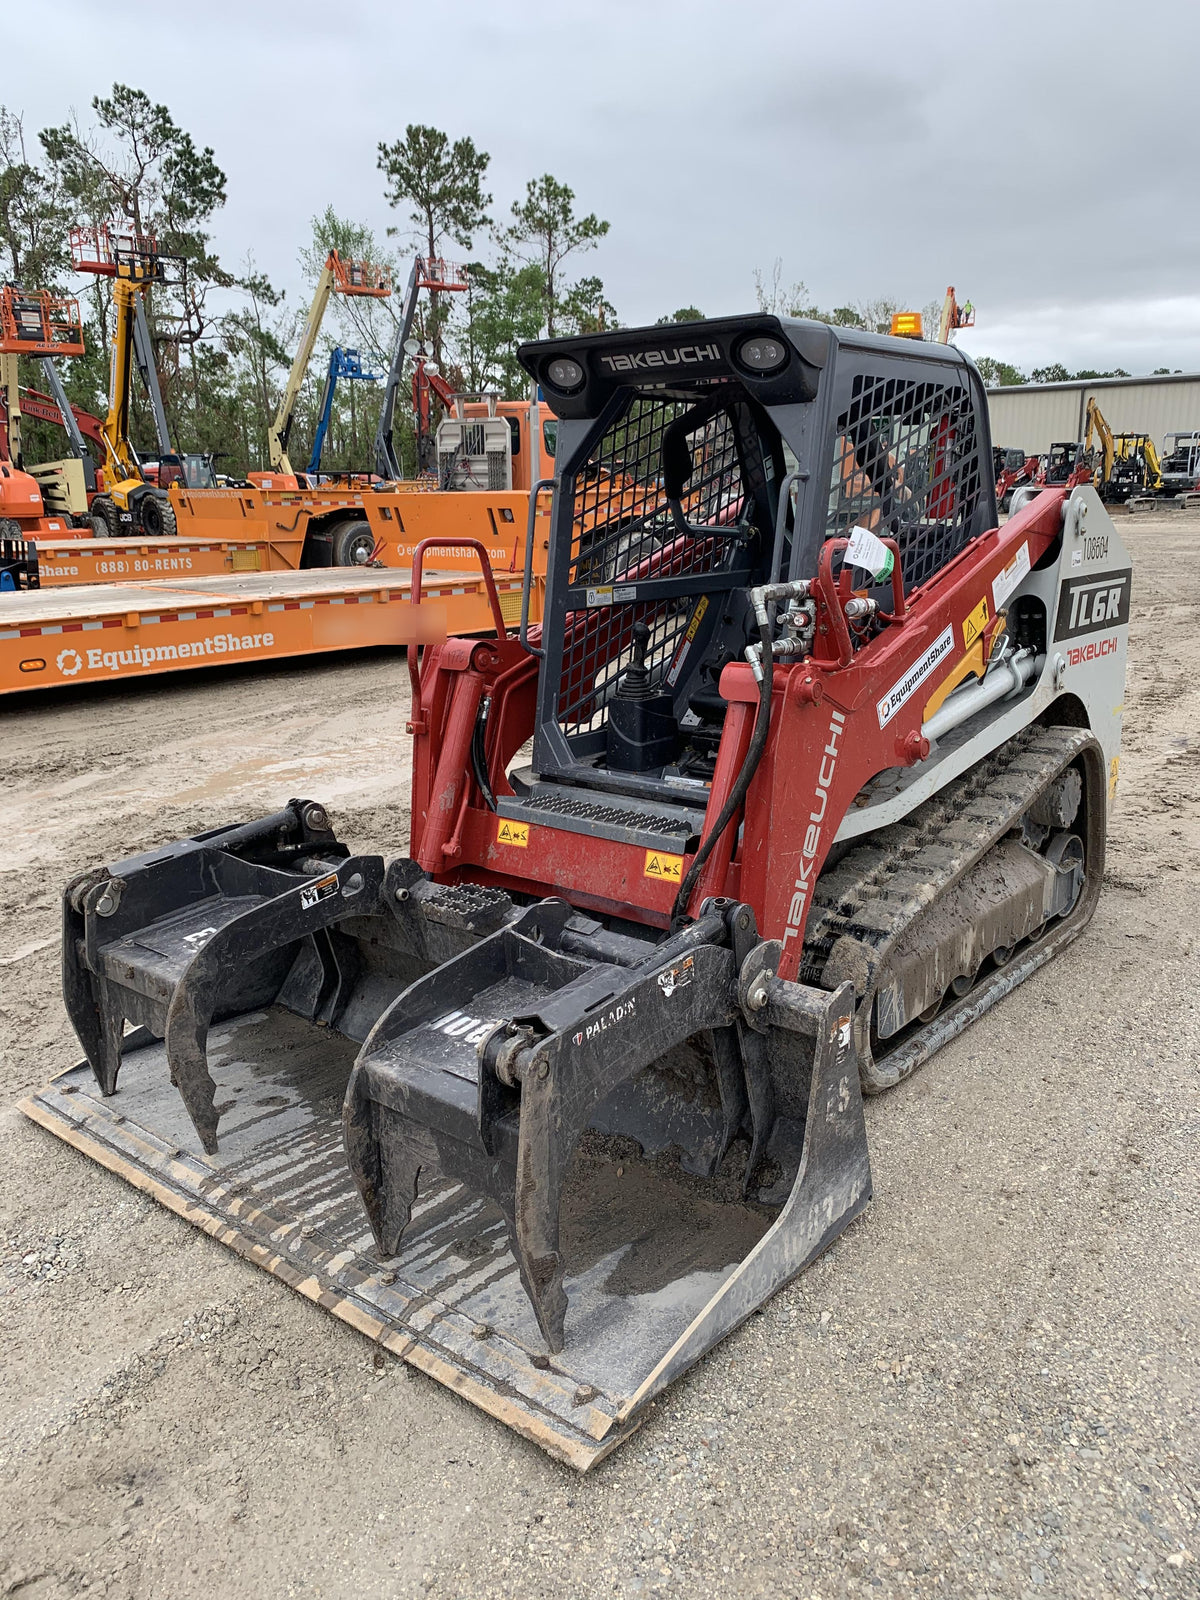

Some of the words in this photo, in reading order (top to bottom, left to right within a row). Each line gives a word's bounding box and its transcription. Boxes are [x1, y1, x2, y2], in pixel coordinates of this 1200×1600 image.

[601, 344, 721, 371] TAKEUCHI
[120, 513, 133, 522] JCB
[95, 560, 130, 575] (888)
[134, 558, 193, 572] 80-RENTS
[1069, 577, 1127, 630] TL6R
[86, 632, 275, 671] EquipmentShare
[1067, 637, 1118, 666] TAKEUCHI
[890, 635, 951, 708] EquipmentShare
[781, 710, 846, 950] TAKEUCHI
